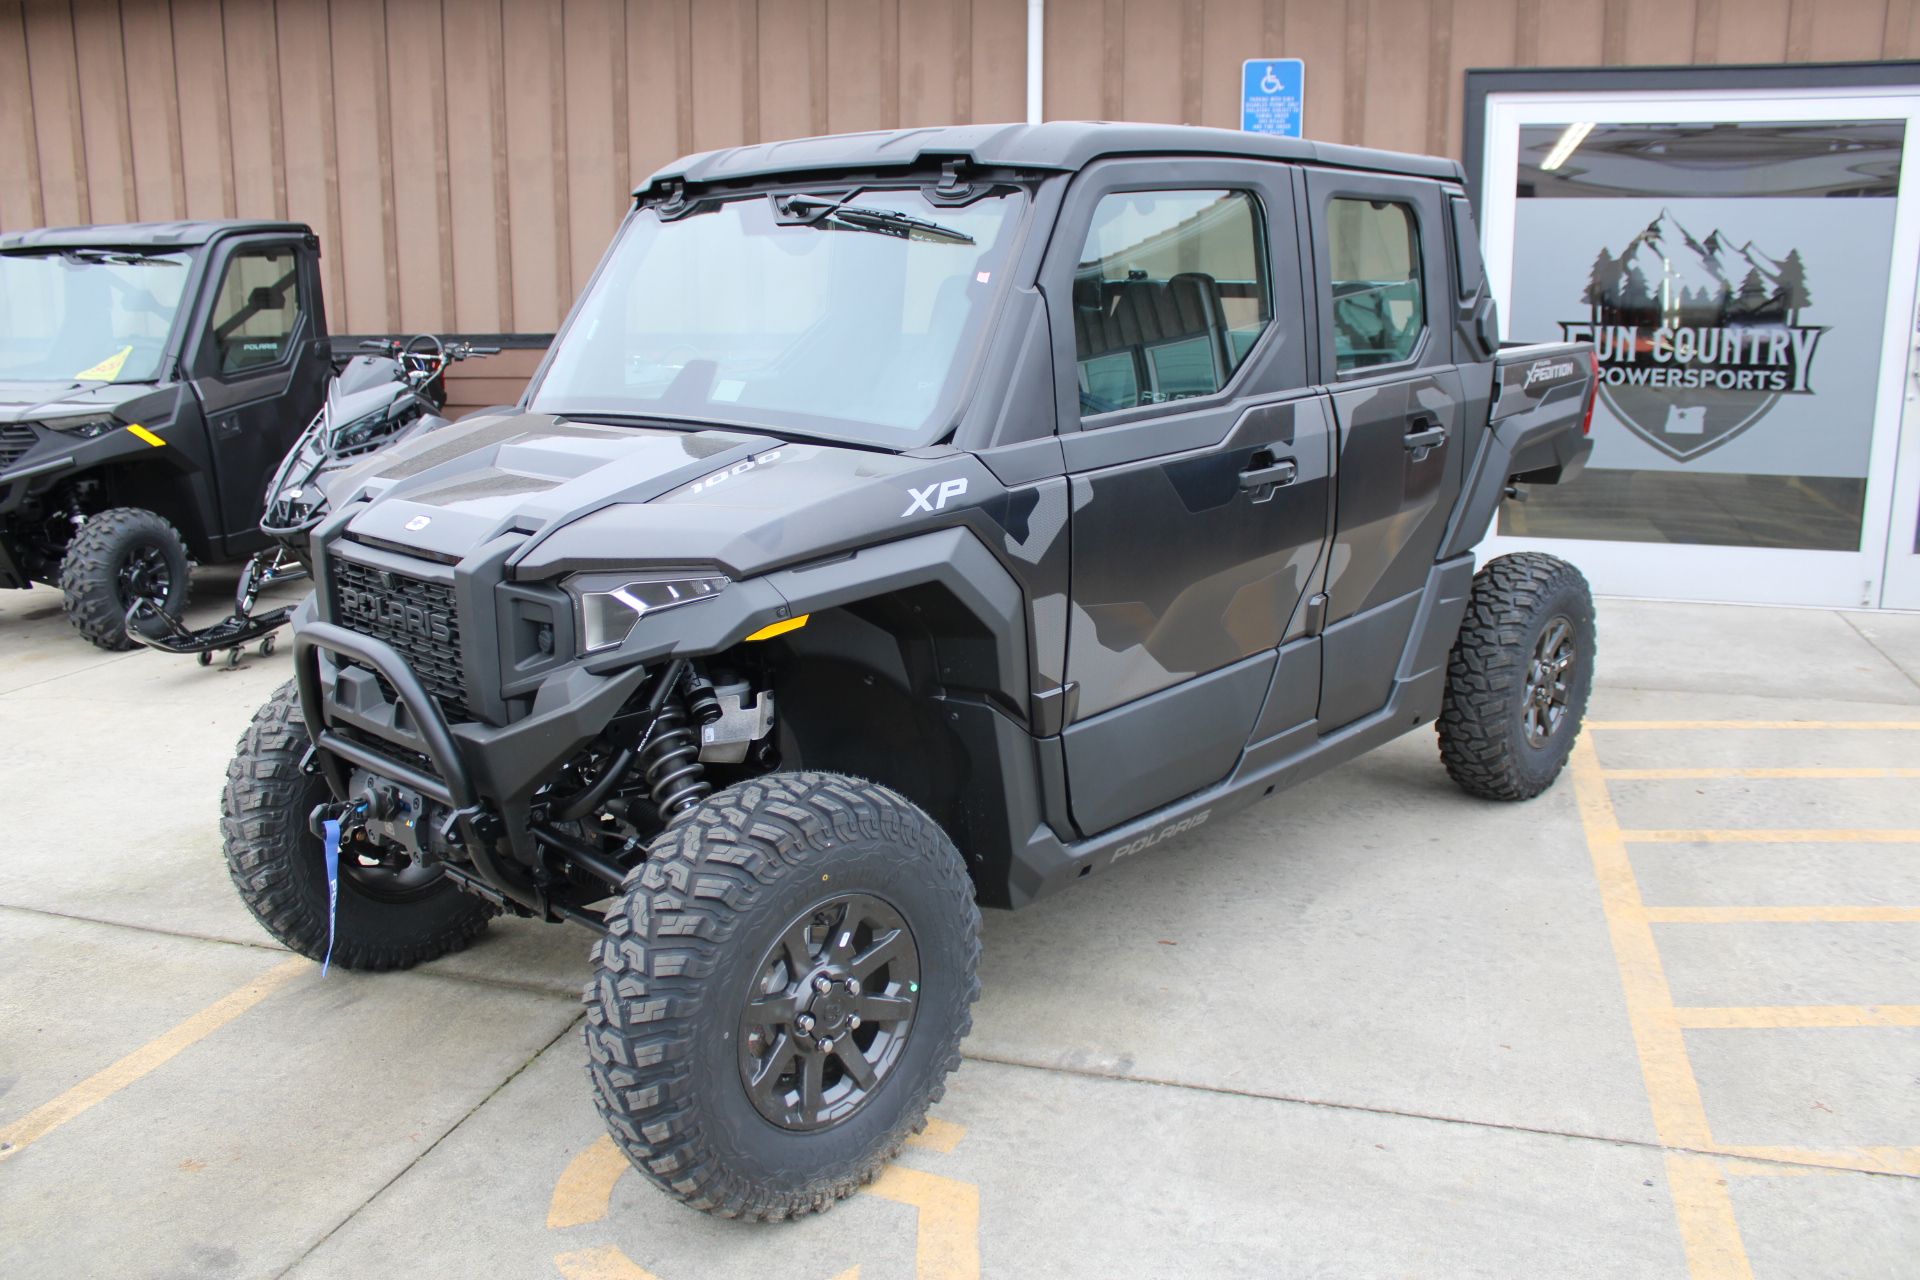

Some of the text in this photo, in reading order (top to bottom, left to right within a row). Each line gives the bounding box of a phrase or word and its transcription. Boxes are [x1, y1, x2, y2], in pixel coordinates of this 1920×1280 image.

[1523, 361, 1574, 390] XPEDITION
[1567, 325, 1821, 392] UN COUNTRY
[691, 451, 781, 495] 1000
[901, 477, 969, 518] XP
[342, 586, 451, 642] POLARIS
[1109, 808, 1213, 864] POLARIS
